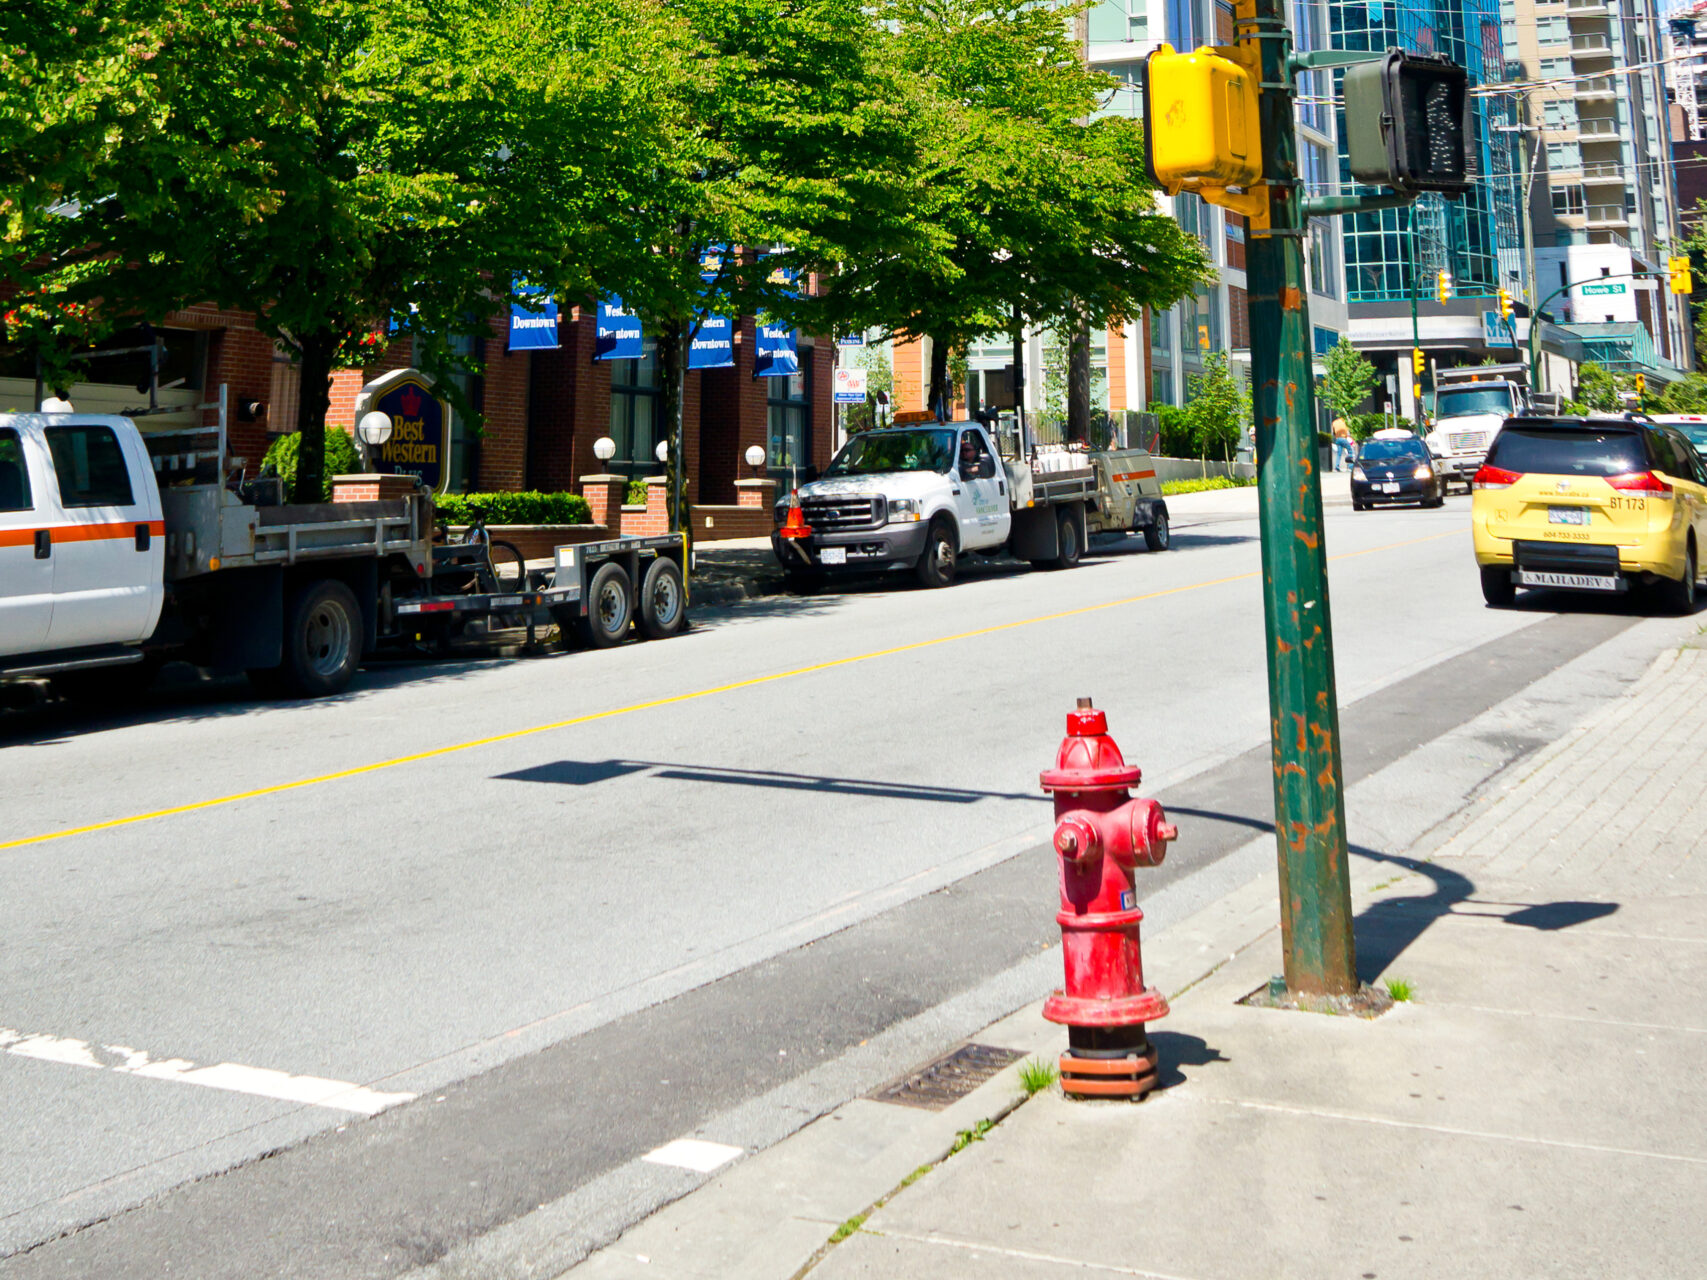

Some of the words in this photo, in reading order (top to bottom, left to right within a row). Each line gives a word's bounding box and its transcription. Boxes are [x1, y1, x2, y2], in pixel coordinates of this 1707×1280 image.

[1584, 286, 1610, 294] Howe
[513, 315, 555, 329] Downtown
[697, 317, 725, 328] estern
[599, 327, 640, 339] Downtown
[692, 338, 730, 350] Downtown
[393, 415, 424, 441] Best
[382, 442, 437, 463] Western
[1610, 497, 1622, 509] BT
[1626, 498, 1645, 510] 173
[1535, 574, 1600, 587] MAHADEV
